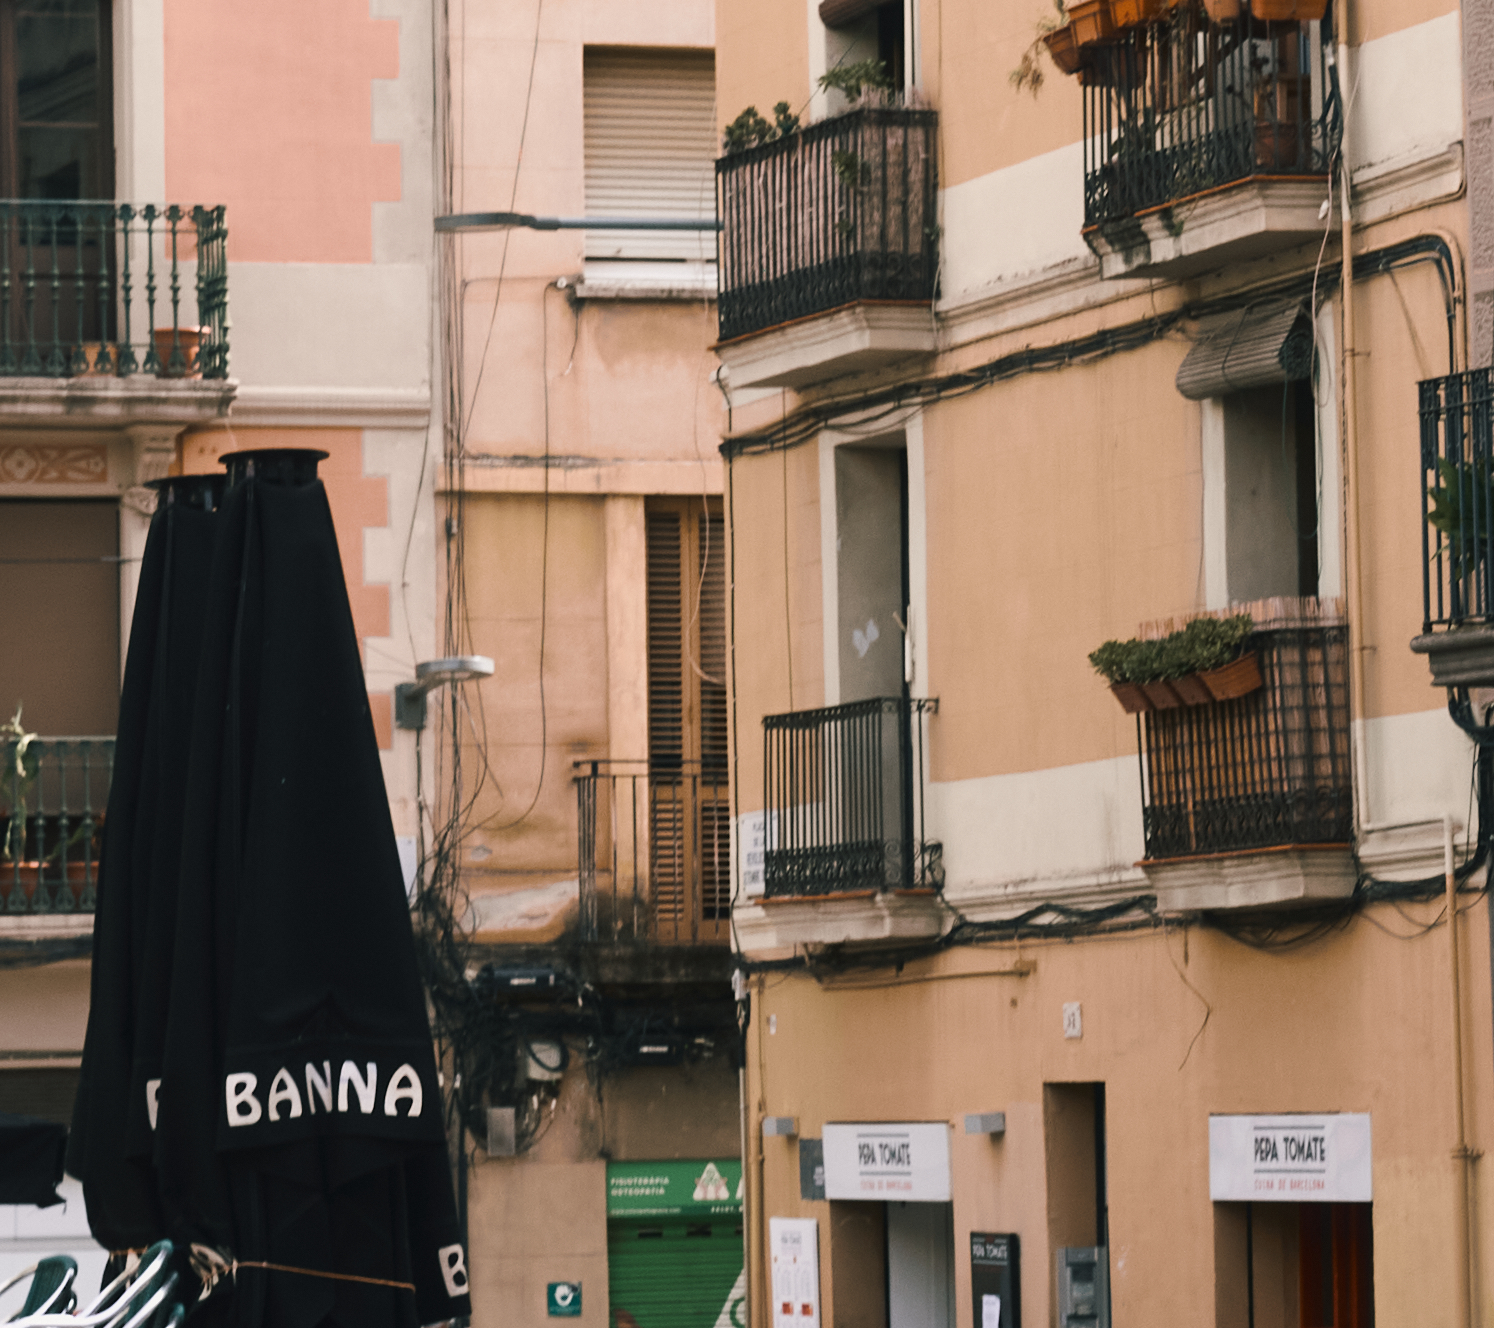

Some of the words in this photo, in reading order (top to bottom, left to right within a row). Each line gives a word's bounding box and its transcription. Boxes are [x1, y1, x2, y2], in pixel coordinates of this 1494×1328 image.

[224, 1059, 424, 1128] BANNA
[1253, 1134, 1279, 1164] PEPA
[1283, 1133, 1326, 1164] TOMATE
